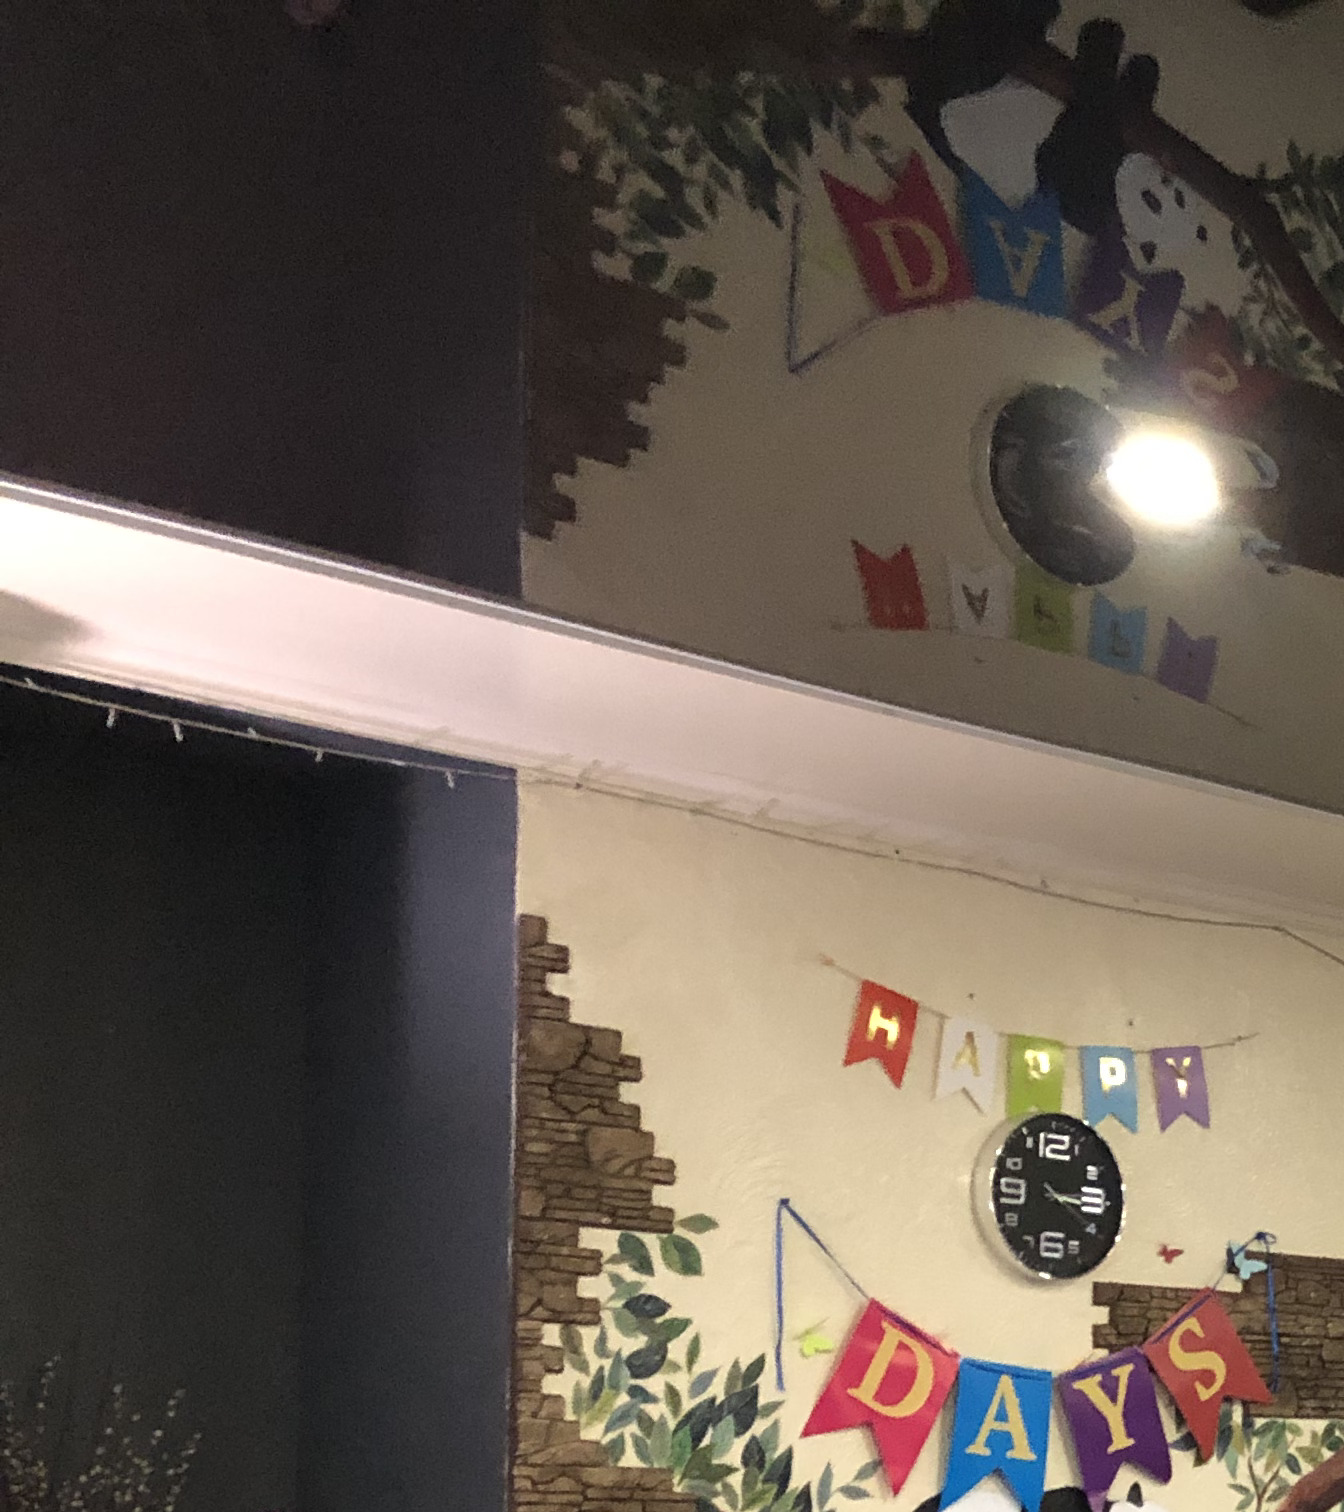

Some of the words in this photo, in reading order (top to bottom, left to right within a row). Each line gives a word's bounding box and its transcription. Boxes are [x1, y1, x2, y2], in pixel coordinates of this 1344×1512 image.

[866, 1004, 1192, 1099] HAPPY
[1038, 1132, 1071, 1162] 12
[1000, 1177, 1027, 1205] 9
[1081, 1186, 1105, 1215] 3
[1039, 1231, 1065, 1259] 6
[847, 1317, 1229, 1460] DAYS
